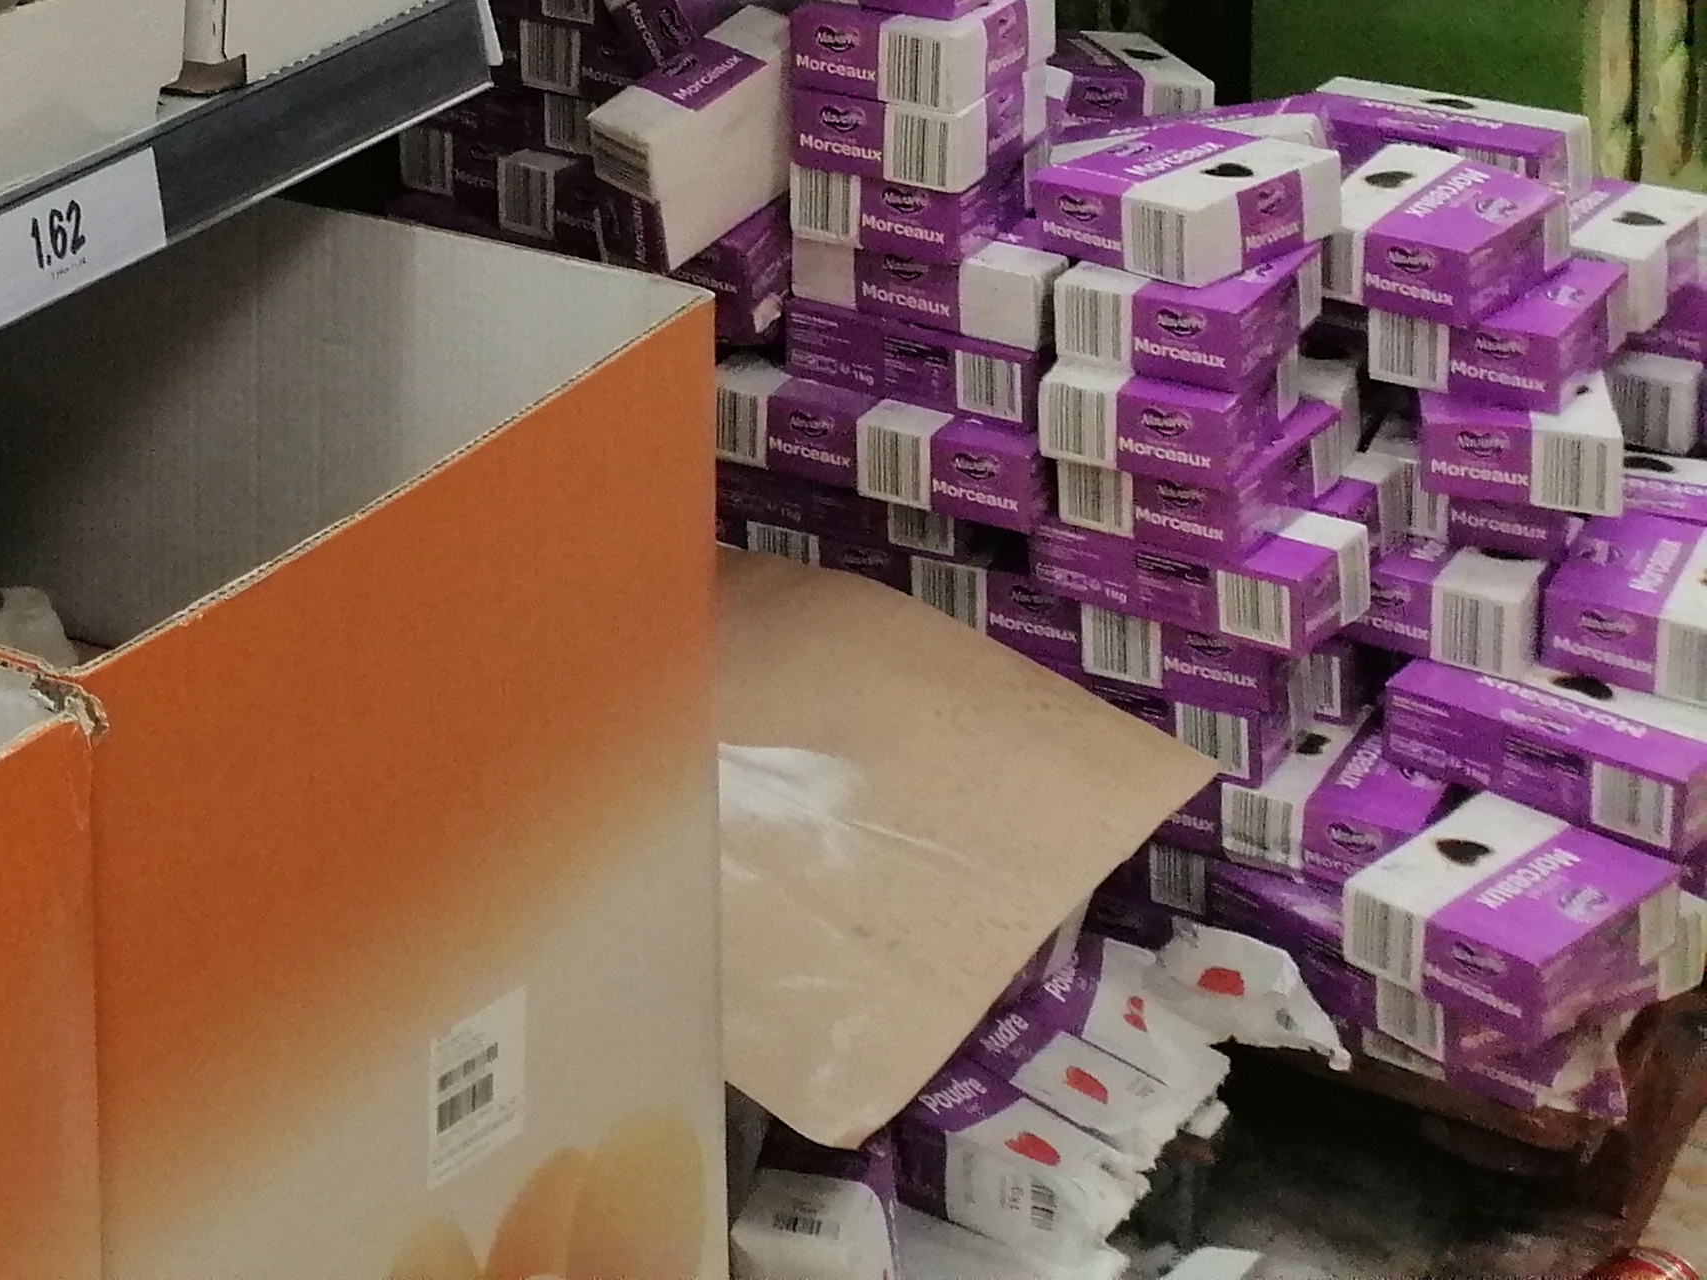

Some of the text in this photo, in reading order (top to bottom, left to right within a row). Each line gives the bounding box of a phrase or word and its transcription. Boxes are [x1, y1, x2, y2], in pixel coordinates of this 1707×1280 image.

[795, 53, 876, 82] Morceaux
[799, 133, 883, 162] Morceaux
[31, 199, 86, 271] 1.62
[861, 213, 944, 244] Morceaux
[862, 281, 951, 318] Morceaux
[1365, 271, 1454, 307] Morceaux
[1134, 338, 1226, 370] Morceaux
[1119, 438, 1211, 468] Morceaux
[1431, 461, 1529, 488] Morceaux
[933, 479, 1019, 513] Morceaux
[918, 1075, 987, 1115] Poudre
